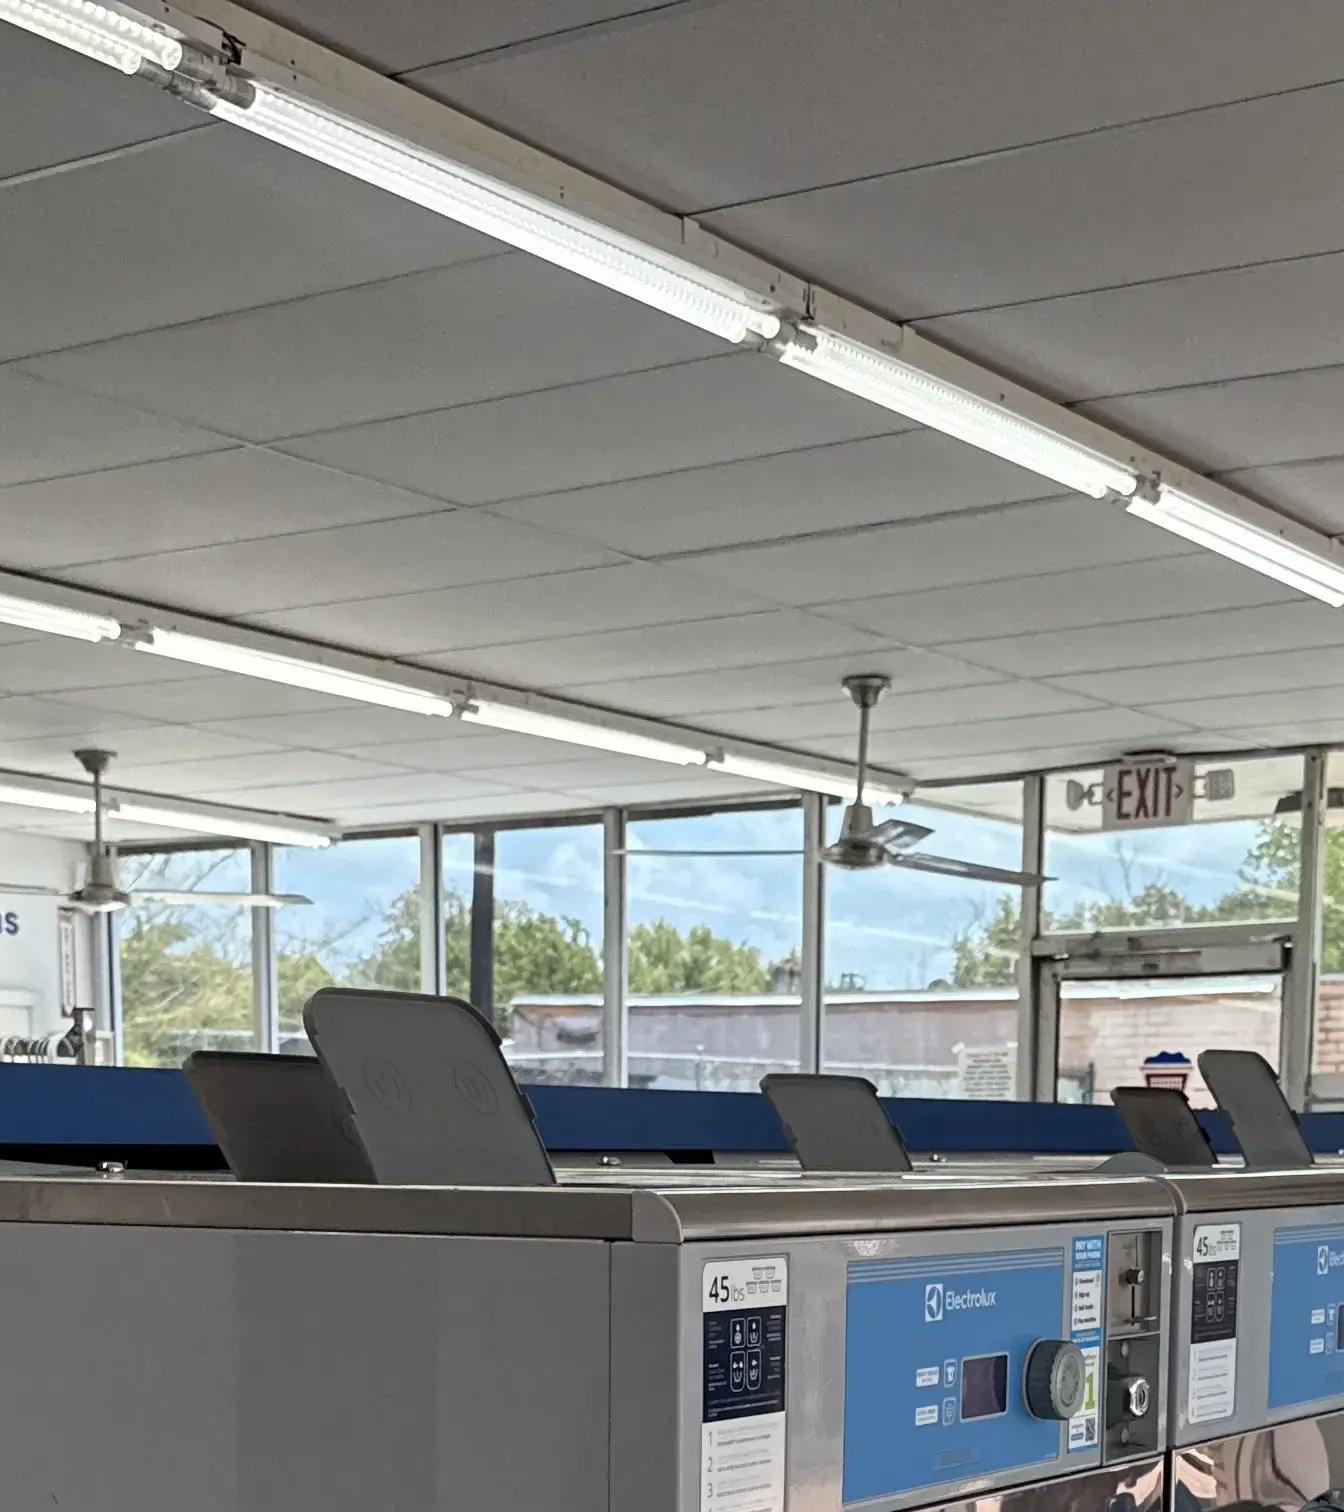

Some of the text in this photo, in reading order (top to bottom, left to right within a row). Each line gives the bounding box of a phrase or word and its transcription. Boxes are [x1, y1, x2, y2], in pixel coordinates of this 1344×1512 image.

[1117, 766, 1176, 819] EXIT
[1196, 1236, 1209, 1256] 45
[709, 1275, 745, 1303] 45 lbs
[945, 1288, 997, 1311] Electrolux
